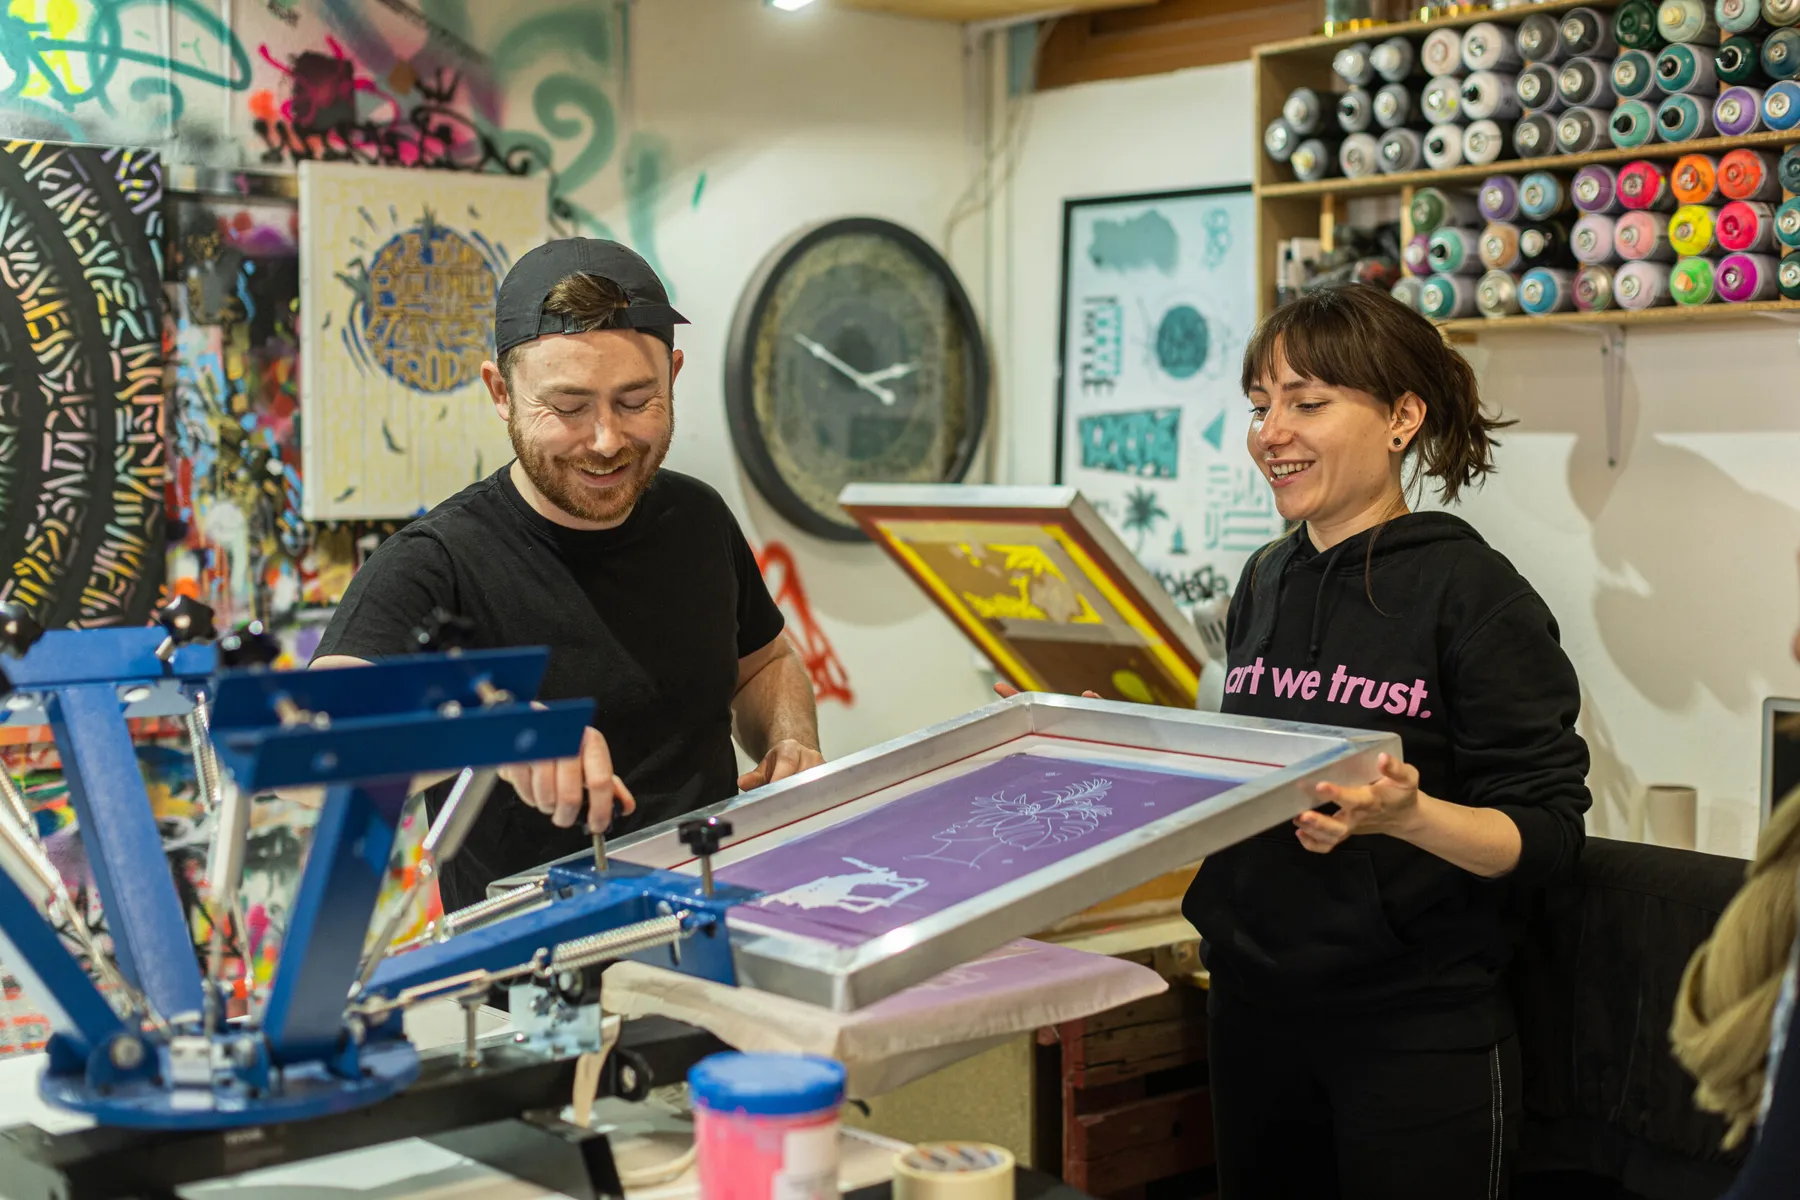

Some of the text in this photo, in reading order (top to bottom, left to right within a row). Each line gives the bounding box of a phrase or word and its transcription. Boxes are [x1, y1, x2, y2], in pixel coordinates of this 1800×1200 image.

[1225, 657, 1432, 718] art we trust.
